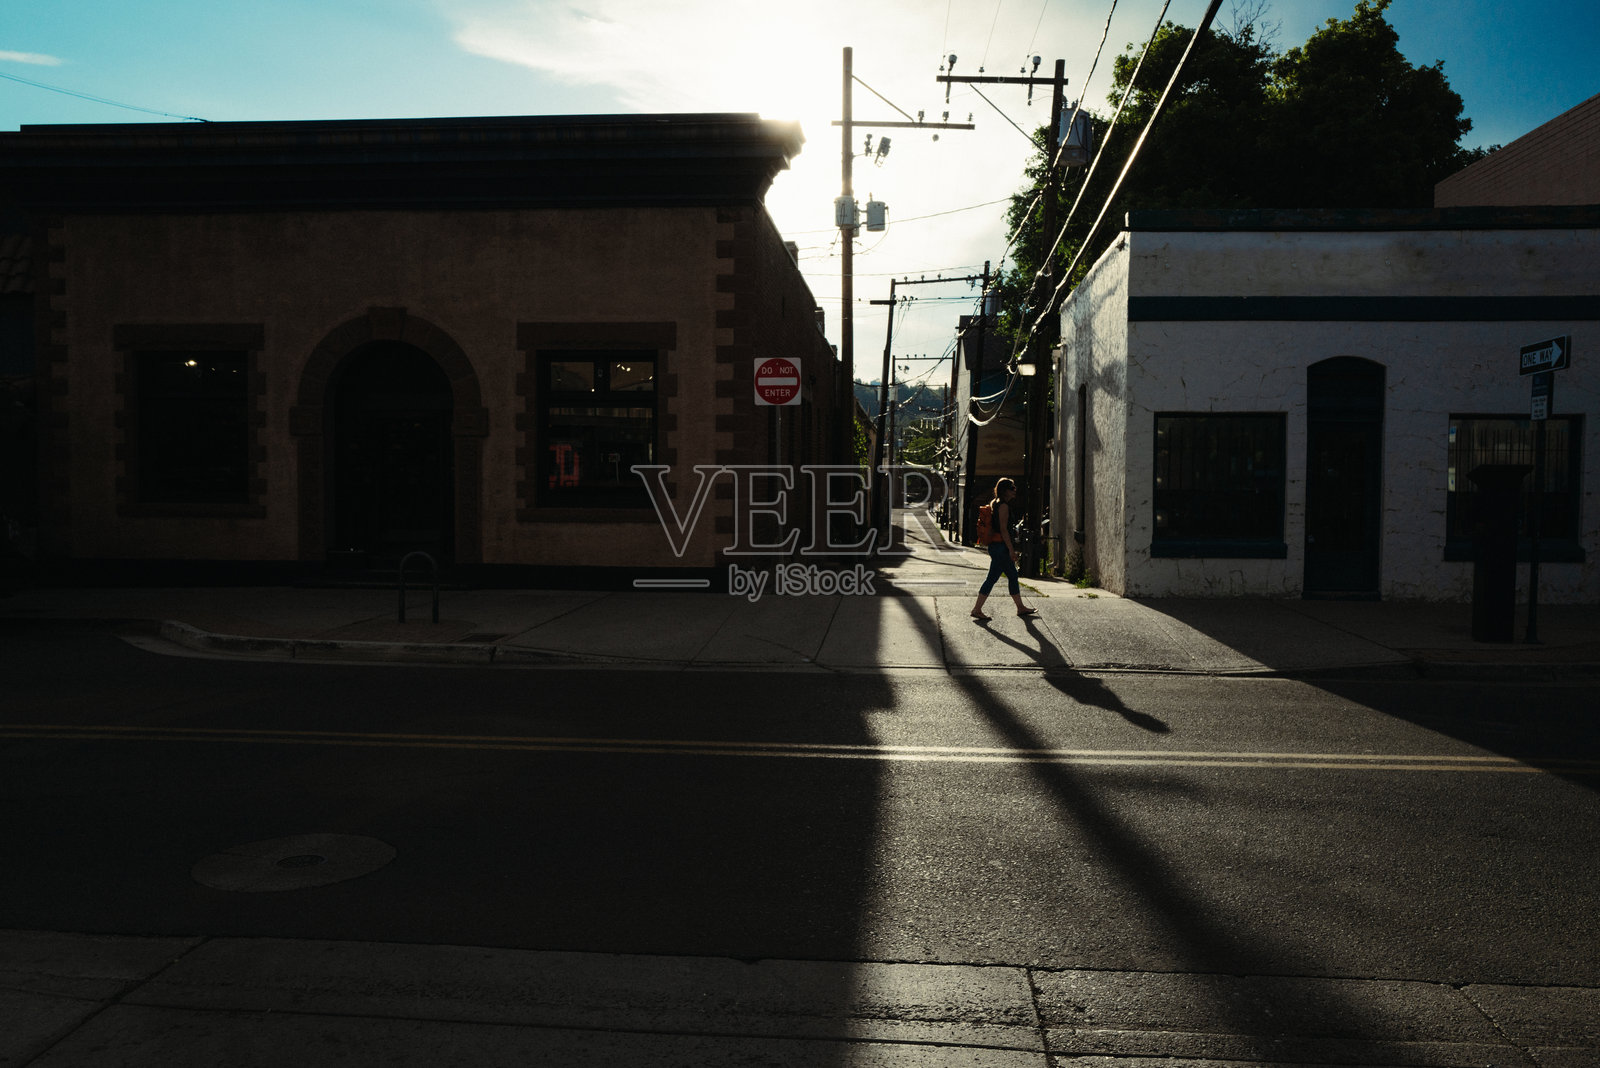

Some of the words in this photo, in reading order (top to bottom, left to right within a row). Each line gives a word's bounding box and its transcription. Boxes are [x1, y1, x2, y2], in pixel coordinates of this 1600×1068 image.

[1523, 352, 1536, 366] ONE
[1539, 349, 1553, 362] WAY
[761, 366, 773, 375] DO
[779, 366, 793, 375] NOT
[764, 388, 791, 398] ENTER
